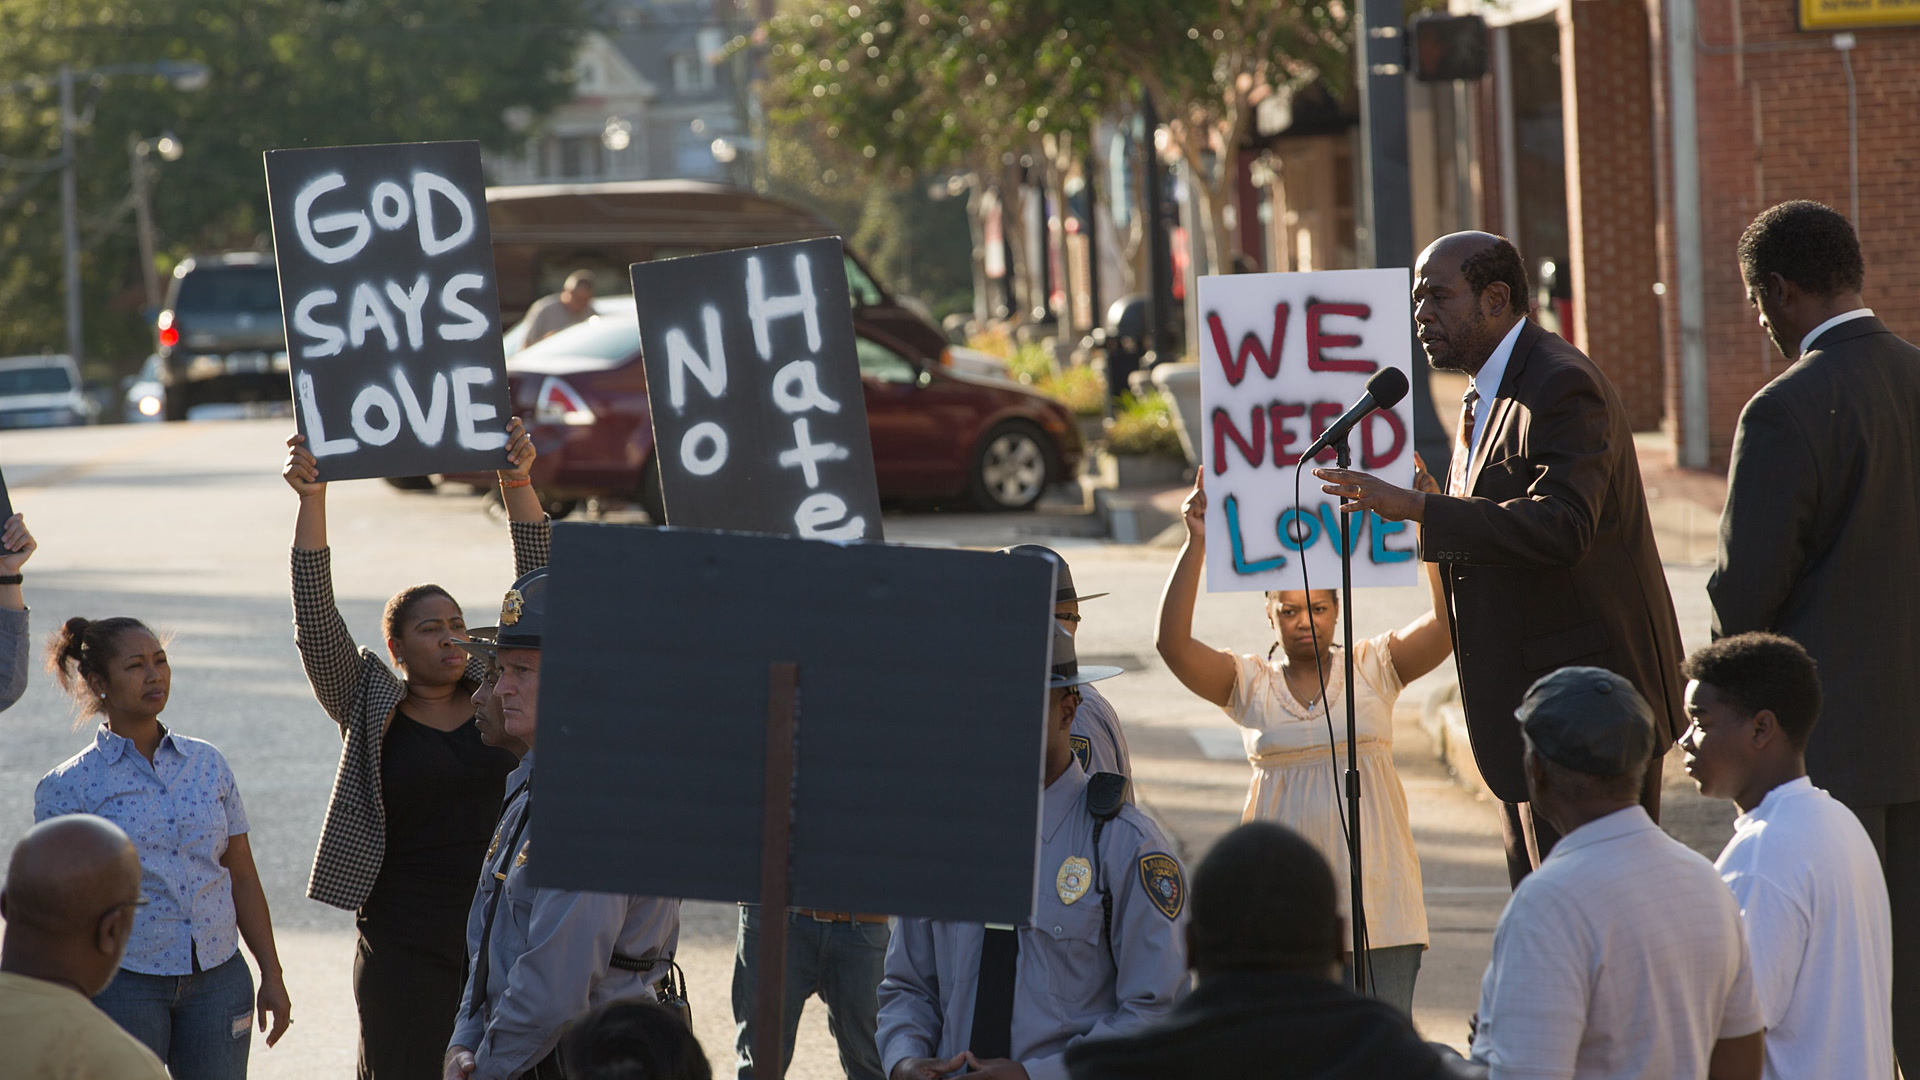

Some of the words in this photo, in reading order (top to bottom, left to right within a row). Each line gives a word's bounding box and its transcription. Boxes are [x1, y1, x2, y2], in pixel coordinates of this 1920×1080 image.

[294, 273, 490, 358] SAYS
[1206, 298, 1378, 386] WE
[298, 366, 509, 458] LOVE
[746, 253, 866, 541] Hate
[1212, 402, 1406, 475] NEED
[1224, 494, 1415, 575] LOVE
